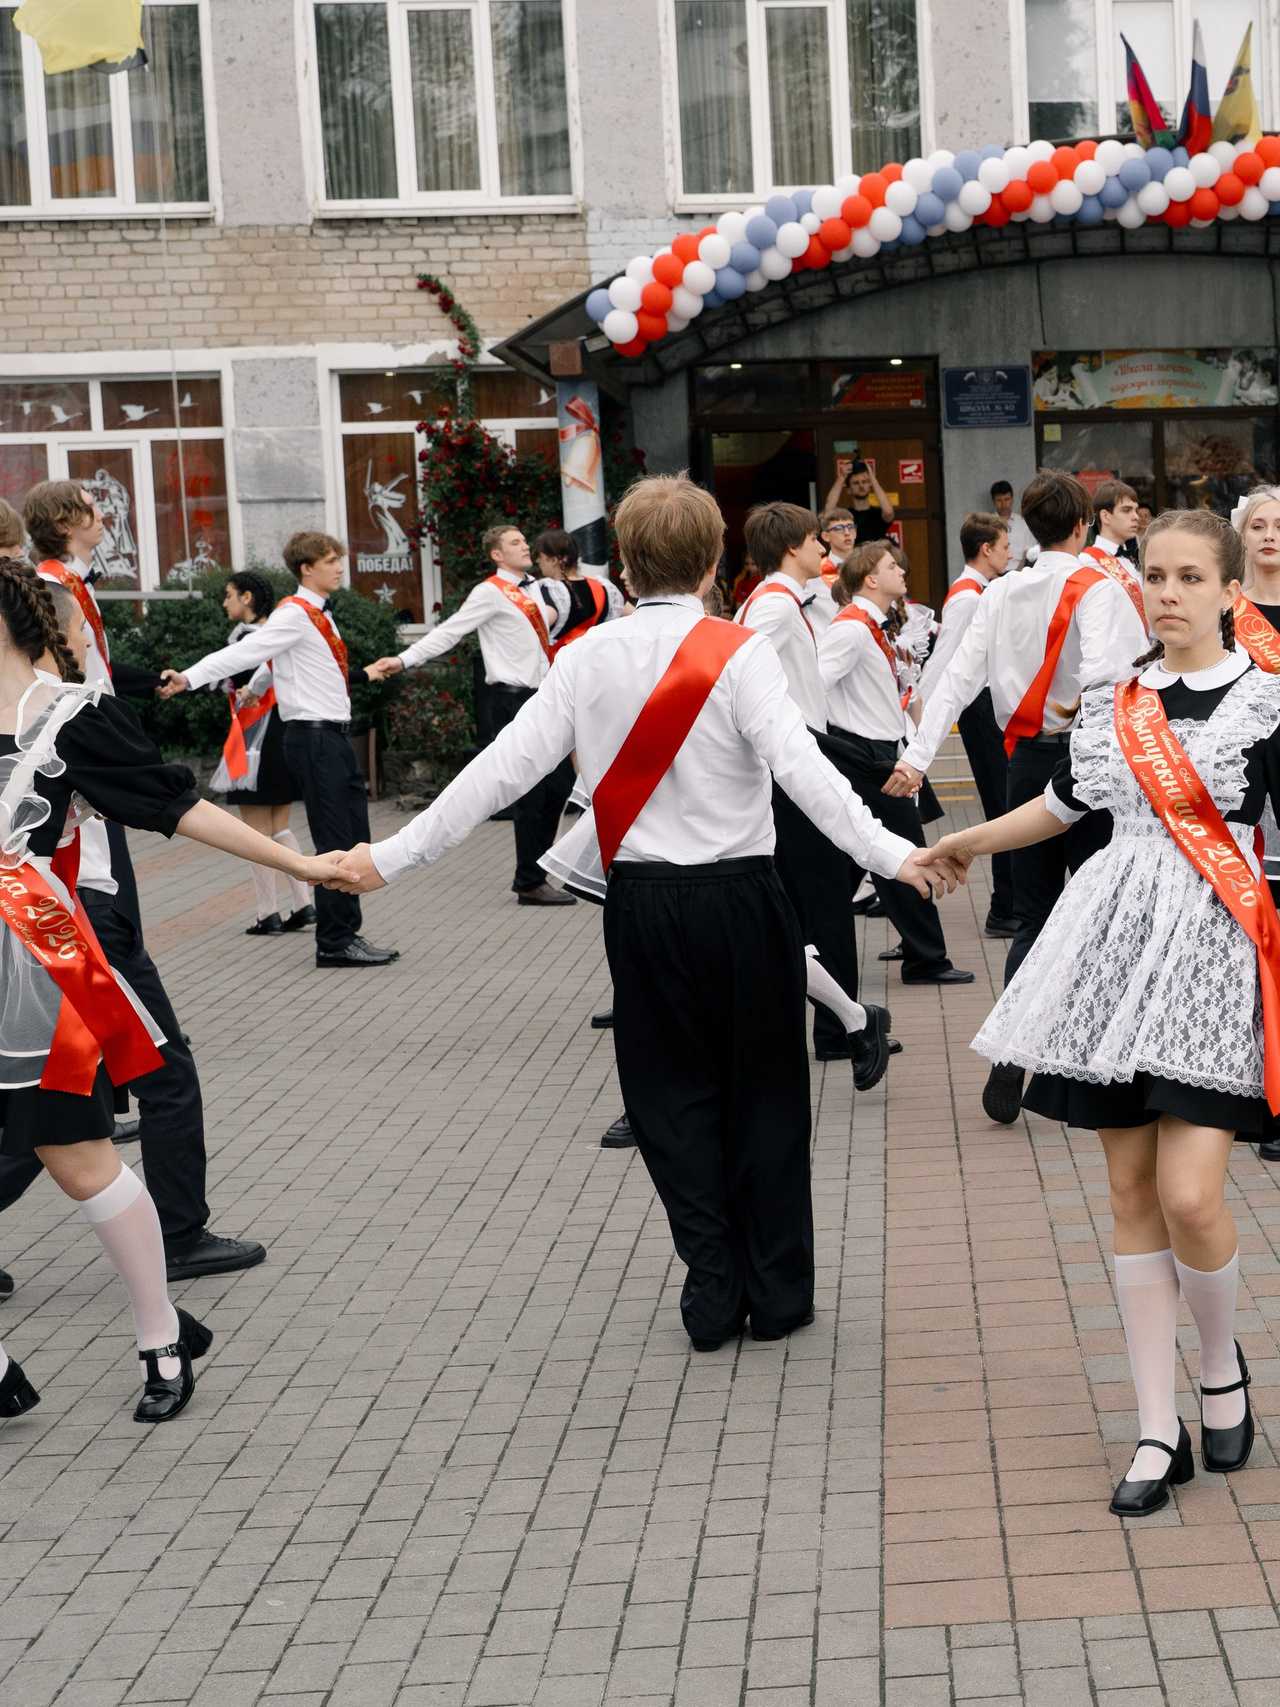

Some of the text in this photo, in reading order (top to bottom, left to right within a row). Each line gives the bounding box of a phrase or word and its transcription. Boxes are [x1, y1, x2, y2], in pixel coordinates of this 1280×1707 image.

[357, 556, 414, 574] ПОБЕДА!
[1126, 694, 1208, 841] Выпускница
[1202, 841, 1264, 907] 2026
[21, 896, 88, 960] 2026
